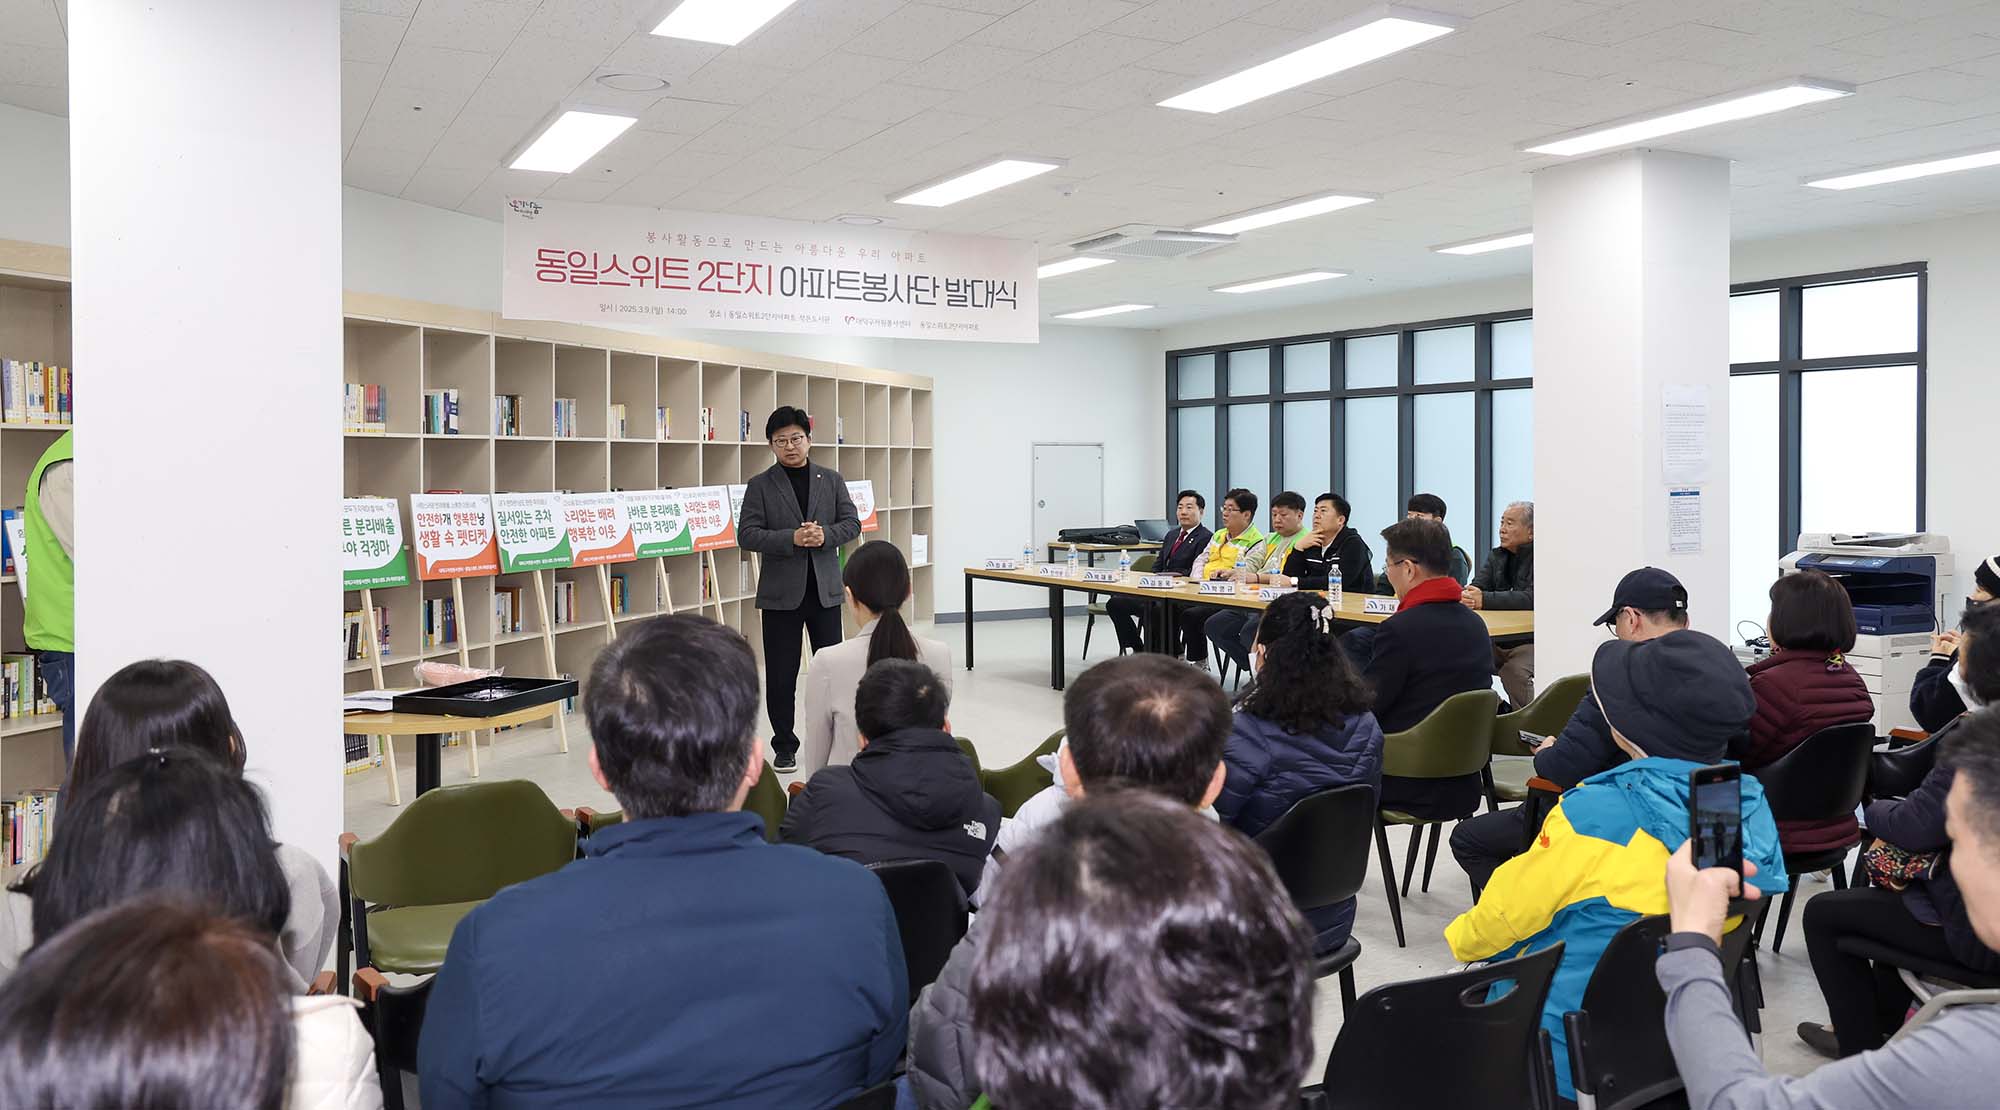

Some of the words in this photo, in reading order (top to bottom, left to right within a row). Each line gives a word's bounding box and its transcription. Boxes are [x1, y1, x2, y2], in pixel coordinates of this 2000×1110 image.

[646, 231, 732, 248] 봉사활동으로
[744, 239, 783, 254] 만드는
[795, 243, 846, 257] 아름다운
[858, 247, 880, 260] 우리
[891, 251, 928, 262] 아파트
[535, 248, 692, 290] 동일스위트
[697, 260, 773, 296] 2단지
[780, 266, 940, 306] 아파트봉사단
[945, 276, 1018, 310] 발대식
[599, 303, 613, 312] 일시
[666, 307, 687, 316] 14:00
[597, 507, 616, 521] 배려
[649, 502, 680, 517] 분리배출
[708, 500, 721, 511] 배려
[355, 516, 395, 536] 분리배출
[416, 512, 452, 528] 안전하개
[453, 511, 486, 526] 행복한냥
[497, 509, 532, 527] 질서있는
[535, 509, 552, 525] 주차
[655, 519, 678, 534] 걱정마
[688, 516, 707, 531] 행복한
[708, 514, 722, 528] 이웃
[419, 530, 441, 549] 생활
[444, 531, 454, 547] 속
[457, 529, 488, 547] 펫티켓
[500, 527, 528, 545] 안전한
[530, 526, 556, 541] 아파트
[568, 525, 596, 543] 행복한
[598, 524, 617, 540] 이웃
[361, 539, 390, 558] 걱정마
